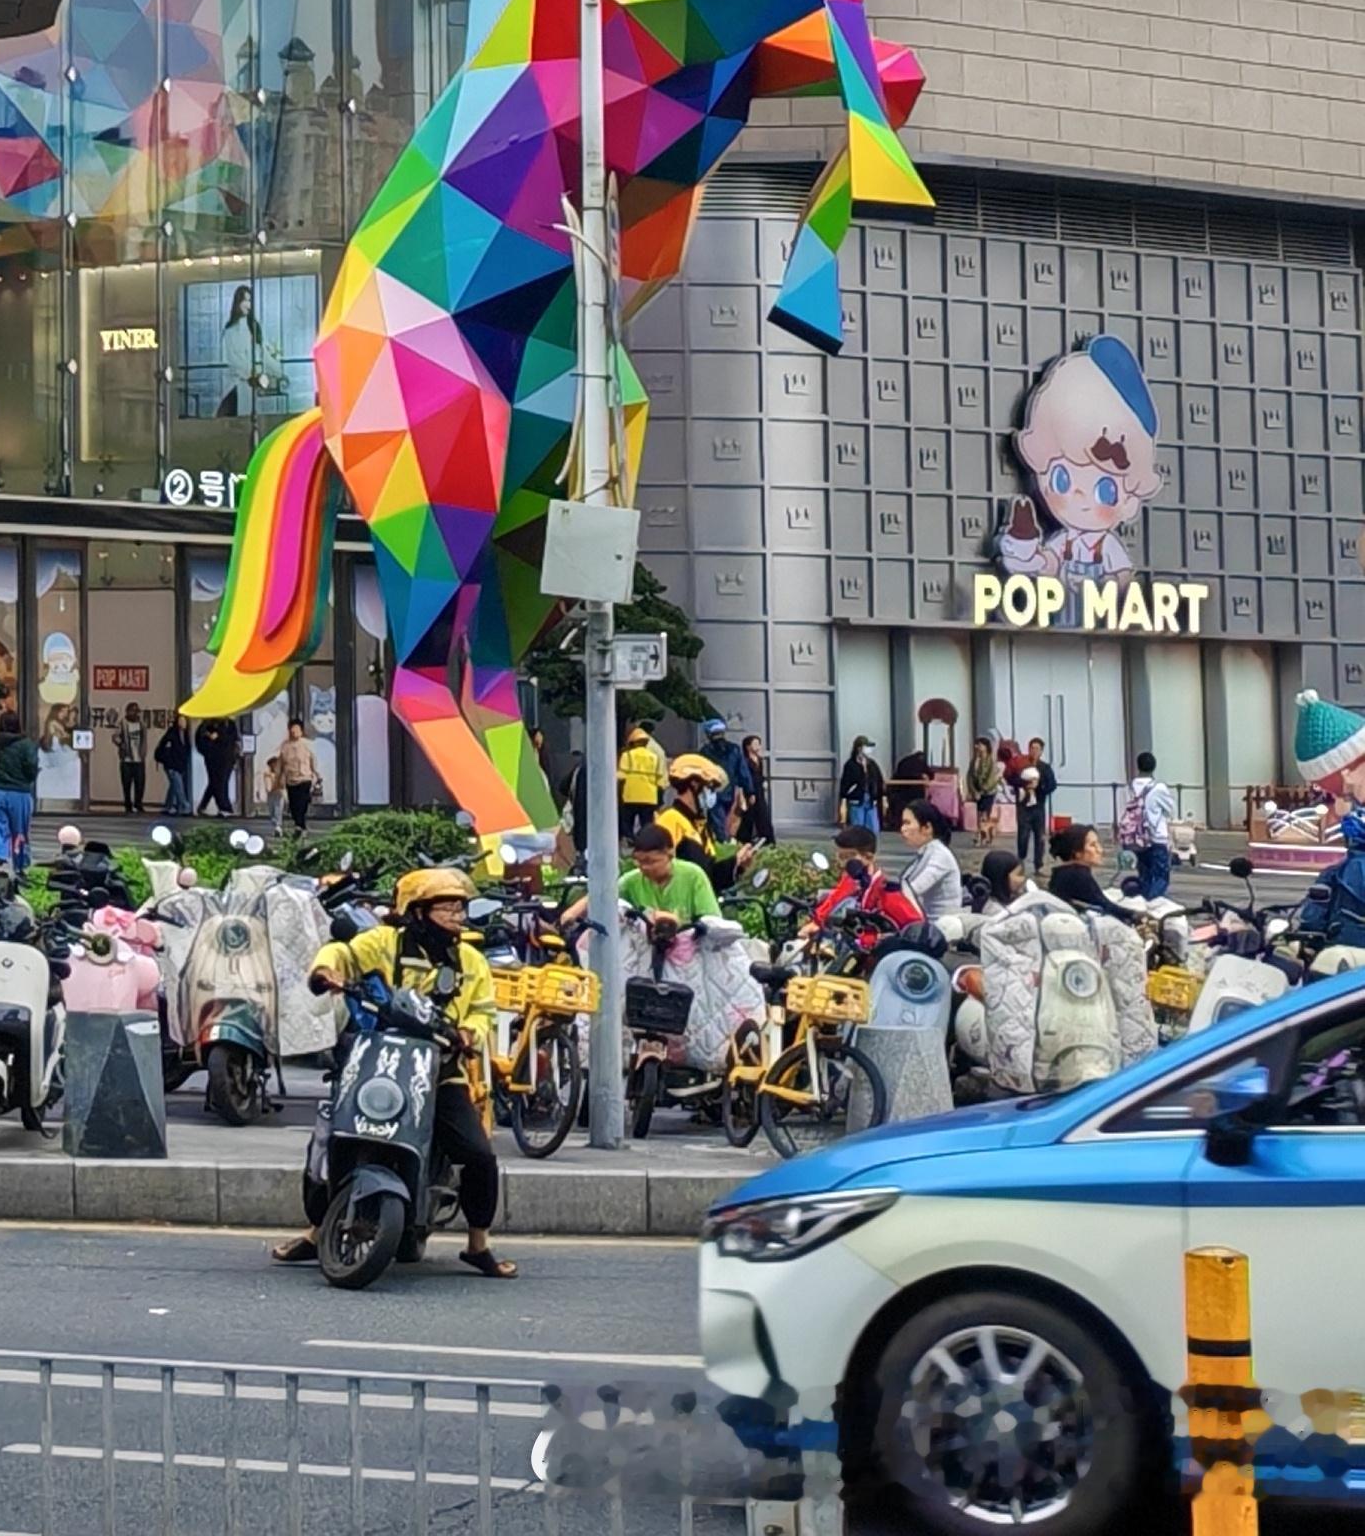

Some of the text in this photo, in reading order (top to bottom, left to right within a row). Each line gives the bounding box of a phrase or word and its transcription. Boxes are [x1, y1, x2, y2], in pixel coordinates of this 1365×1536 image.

[100, 327, 158, 352] YINER
[972, 573, 1209, 634] POP MART
